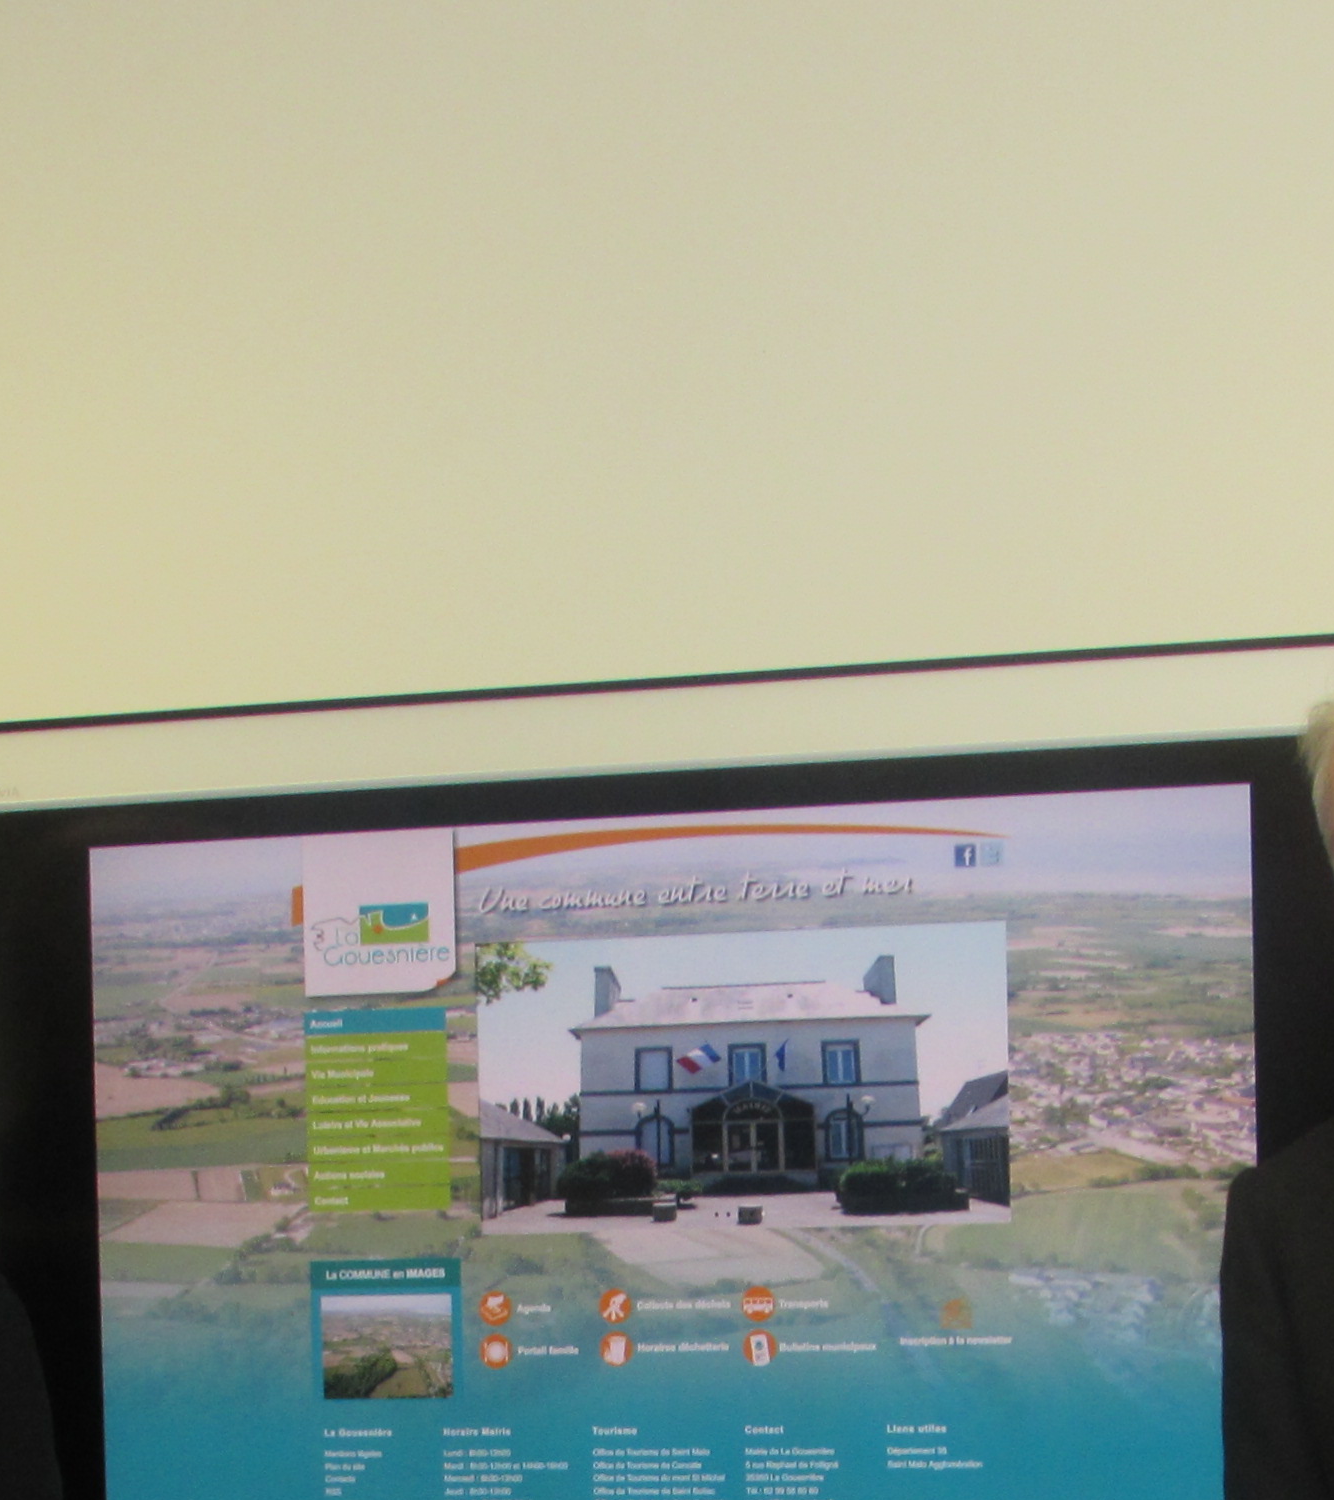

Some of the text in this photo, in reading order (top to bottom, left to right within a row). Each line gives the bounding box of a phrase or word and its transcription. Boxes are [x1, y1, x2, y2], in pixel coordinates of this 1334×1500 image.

[478, 867, 914, 914] Une commune entre terre et mer
[336, 927, 359, 946] La
[323, 943, 450, 967] Gouesnière
[309, 1018, 344, 1030] Accueil
[310, 1043, 366, 1056] Informations
[311, 1068, 375, 1081] Vie Municipale
[357, 1094, 367, 1104] et
[344, 1119, 353, 1129] et
[354, 1119, 369, 1129] Vie
[314, 1145, 361, 1156] Urbanisme
[362, 1145, 371, 1154] et
[412, 1142, 444, 1154] publics
[313, 1196, 349, 1206] Contact
[325, 1267, 446, 1281] La COMMUNE en IMAGES
[517, 1303, 551, 1315] Agenda
[637, 1299, 731, 1312] Collecte des déchets
[779, 1299, 829, 1310] Transports
[779, 1341, 878, 1353] Bulletins municipaux
[900, 1336, 947, 1347] Inscription
[966, 1335, 1013, 1345] newsletter
[517, 1345, 547, 1356] Portail
[637, 1343, 676, 1353] Horaires
[324, 1428, 336, 1438] La
[481, 1427, 511, 1436] Mairie
[593, 1426, 638, 1436] Tourisme
[744, 1425, 784, 1435] Contact
[886, 1424, 947, 1434] Liens utiles
